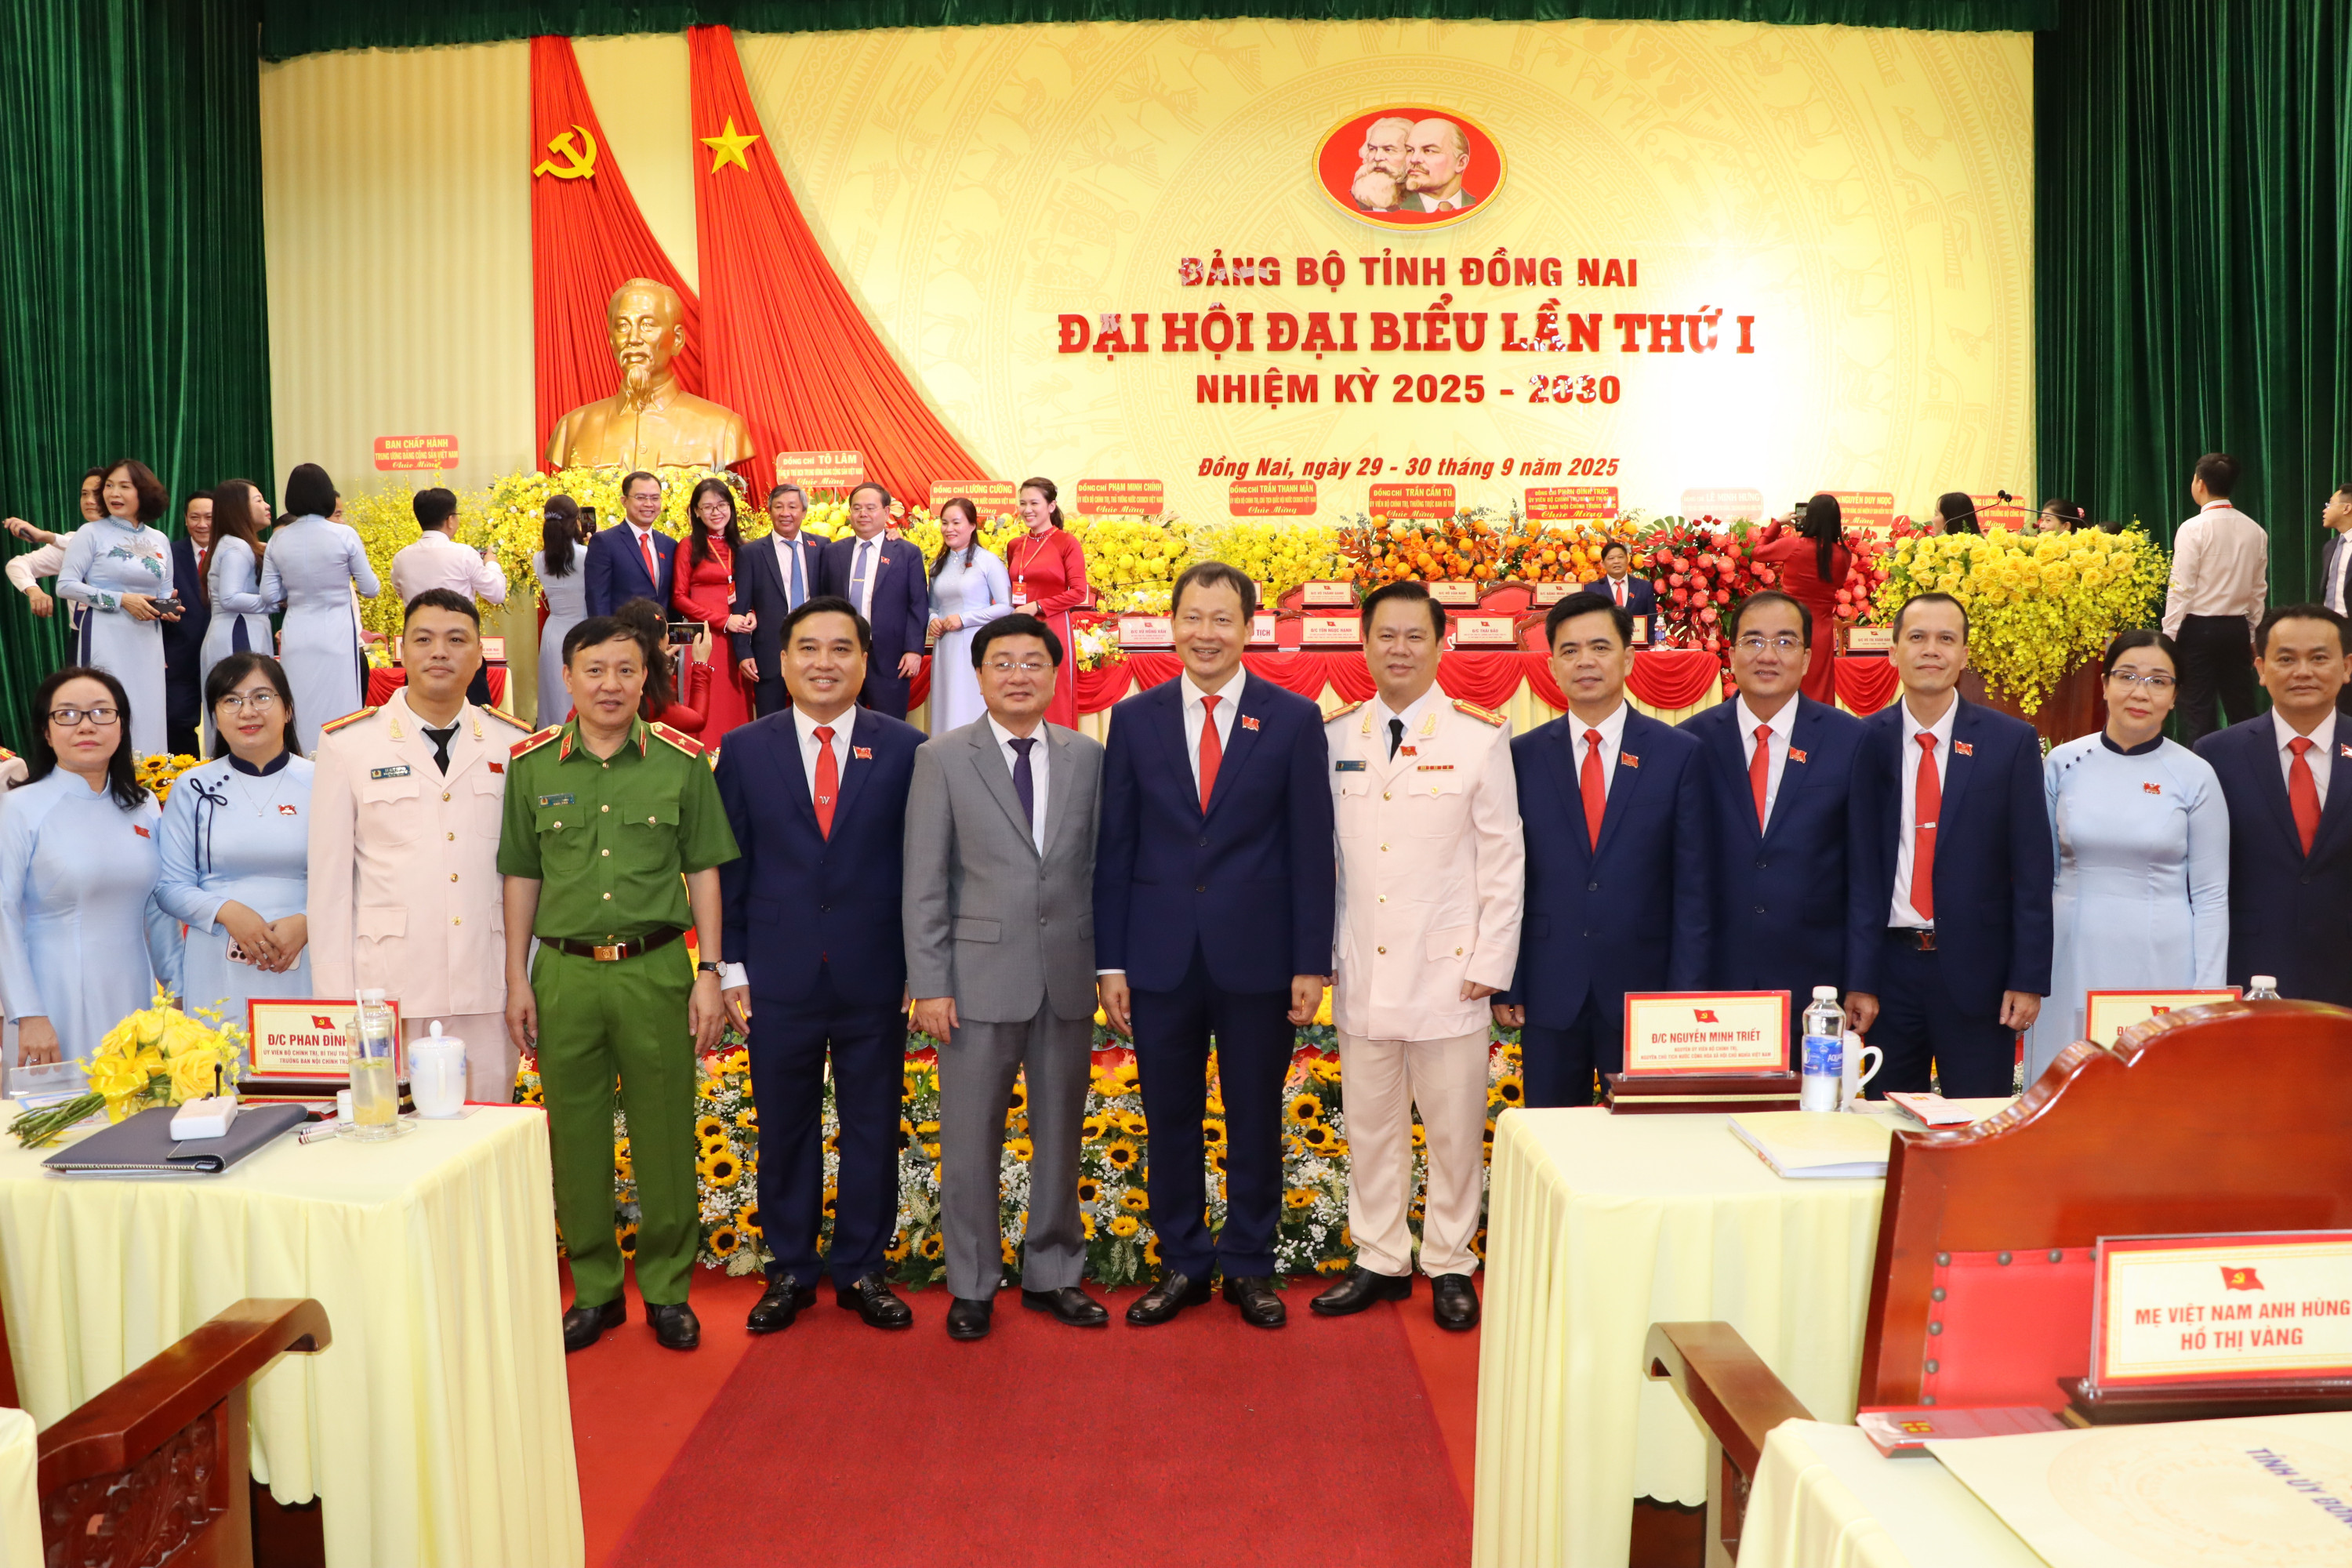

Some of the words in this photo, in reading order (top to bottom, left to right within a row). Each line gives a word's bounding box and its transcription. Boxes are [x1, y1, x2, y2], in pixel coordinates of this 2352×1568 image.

[1178, 249, 1280, 286] ĐẢNG
[1297, 250, 1345, 292] BỘ
[1359, 248, 1450, 286] TỈNH
[1460, 247, 1562, 286] ĐỒNG
[1578, 258, 1637, 286] NAI
[1058, 314, 1149, 361] ĐẠI
[1162, 303, 1254, 361] HỘI
[1267, 312, 1357, 360] ĐẠI
[1371, 293, 1487, 352] BIỂU
[1501, 298, 1602, 352] LẦN
[1614, 305, 1722, 353] THỨ
[1737, 316, 1755, 353] I
[1197, 367, 1318, 409] NHIỆM
[1335, 366, 1379, 403] KỲ
[1393, 374, 1484, 404] 2025
[1529, 375, 1621, 404] 2030
[403, 437, 424, 448] CHẤP
[426, 437, 448, 448] HÀNH
[783, 456, 801, 465] ĐỒNG
[818, 453, 832, 464] TÔ
[835, 452, 856, 464] LÂM
[1198, 456, 1250, 481] Đồng
[1255, 458, 1294, 480] Nai,
[1302, 458, 1352, 481] ngày
[1356, 457, 1384, 476] 29
[1405, 458, 1432, 476] 30
[1438, 457, 1495, 480] tháng
[1501, 458, 1515, 476] 9
[1519, 458, 1563, 476] năm
[1567, 458, 1620, 477] 2025
[934, 485, 952, 493] ĐỒNG
[966, 484, 987, 493] LƯƠNG
[989, 483, 1012, 493] CƯỜNG
[1109, 483, 1125, 492] PHẠM
[1144, 481, 1161, 491] CHÍNH
[1230, 485, 1247, 493] ĐỒNG
[1260, 481, 1276, 492] TRẦN
[1374, 488, 1391, 496] ĐỒNG
[1406, 485, 1424, 496] TRẦN
[1426, 485, 1441, 496] CẨM
[1443, 487, 1452, 496] TÚ
[1842, 492, 1863, 503] NGUYỄN
[268, 1034, 286, 1046] Đ/C
[290, 1034, 319, 1046] PHAN
[1652, 1033, 1667, 1044] Đ/C
[1670, 1029, 1706, 1043] NGUYỄN
[1709, 1032, 1733, 1042] MINH
[1737, 1028, 1760, 1041] TRIẾT
[2136, 1308, 2161, 1327] MẸ
[2169, 1303, 2205, 1327] VIỆT
[2212, 1304, 2252, 1321] NAM
[2259, 1302, 2295, 1319] ANH
[2302, 1297, 2351, 1317] HÙNG
[2181, 1326, 2205, 1351] HỒ
[2214, 1331, 2243, 1352] THỊ
[2250, 1325, 2303, 1347] VÀNG
[2245, 1447, 2299, 1475] TỈNH
